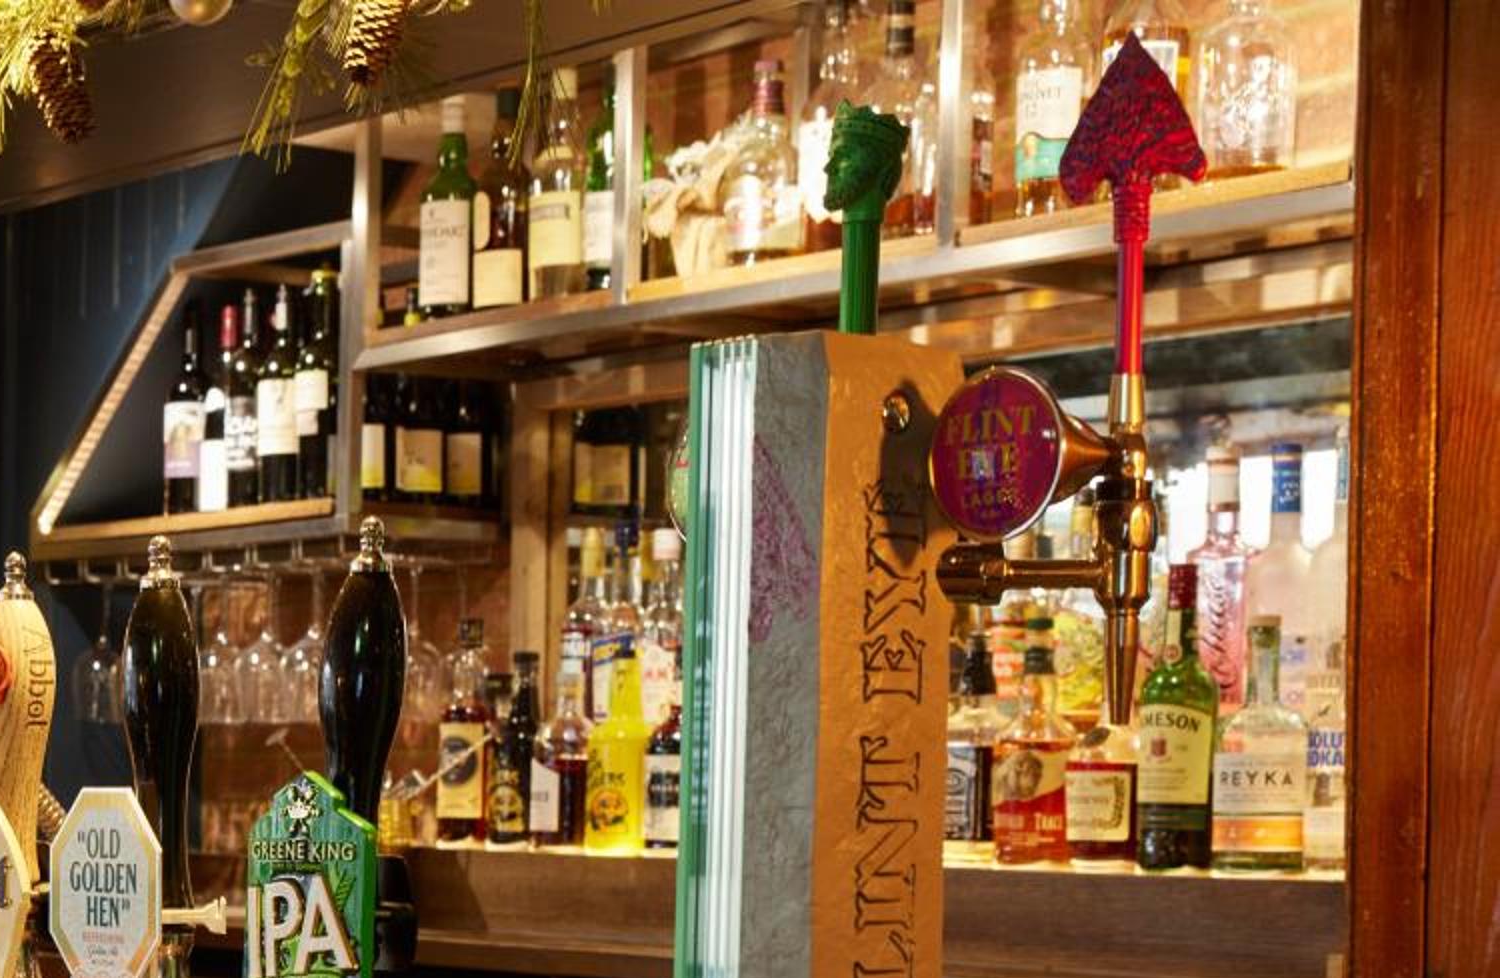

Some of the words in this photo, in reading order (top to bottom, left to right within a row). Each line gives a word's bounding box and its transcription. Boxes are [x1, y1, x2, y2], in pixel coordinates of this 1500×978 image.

[947, 406, 1035, 445] FLINT
[861, 480, 927, 704] EYE
[22, 625, 54, 728] Abbot
[1219, 770, 1294, 786] REYKA
[251, 840, 305, 860] GREENE
[308, 841, 355, 862] KING
[69, 861, 138, 895] GOLDEN
